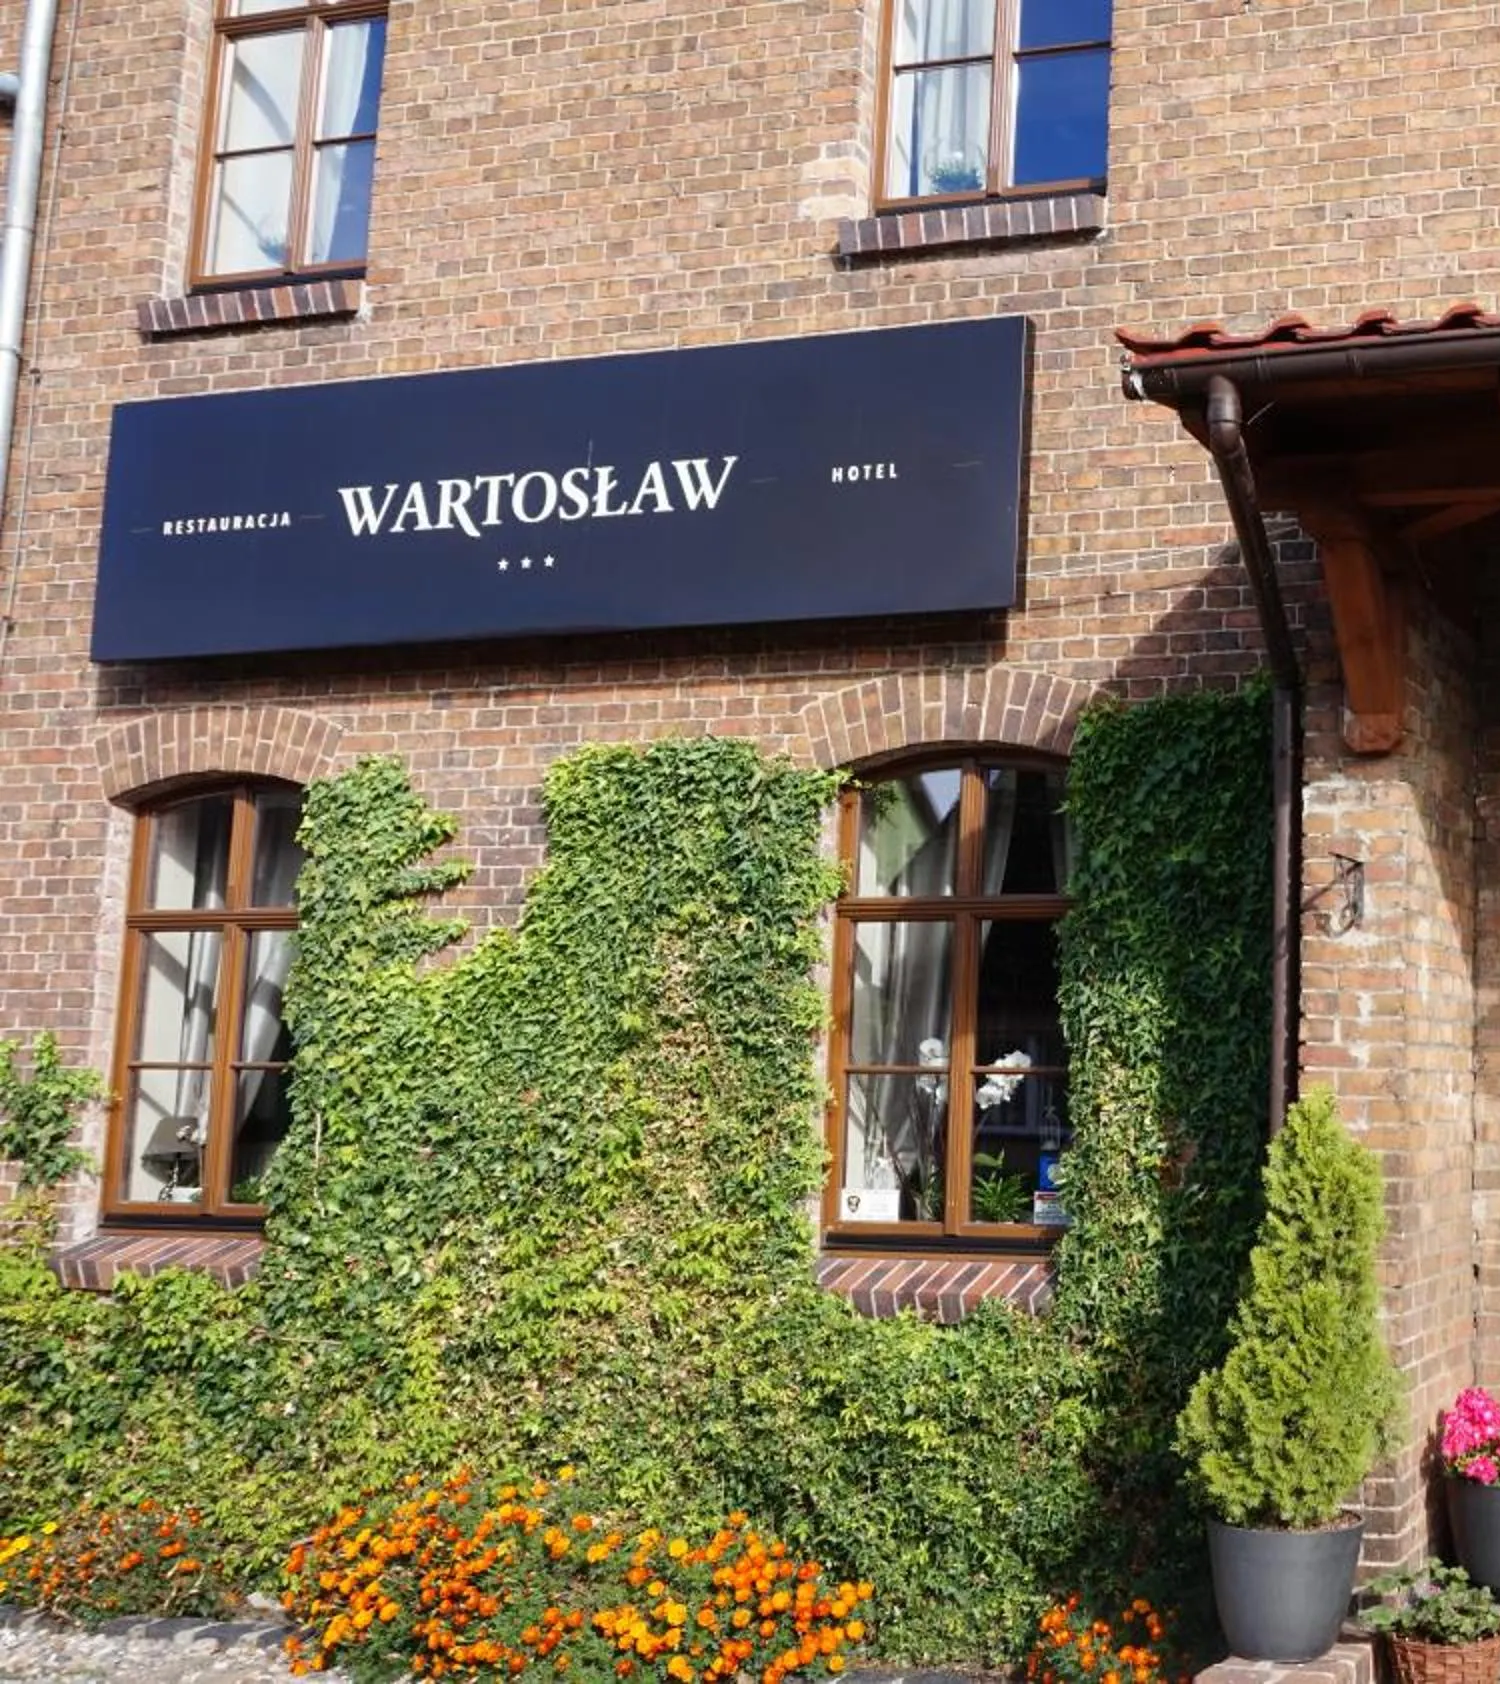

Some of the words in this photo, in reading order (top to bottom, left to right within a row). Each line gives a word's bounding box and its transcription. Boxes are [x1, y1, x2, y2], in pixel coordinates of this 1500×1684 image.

[831, 462, 898, 484] HOTEL
[337, 455, 739, 538] WARTOSŁAW
[162, 511, 292, 536] RESTAURACJA
